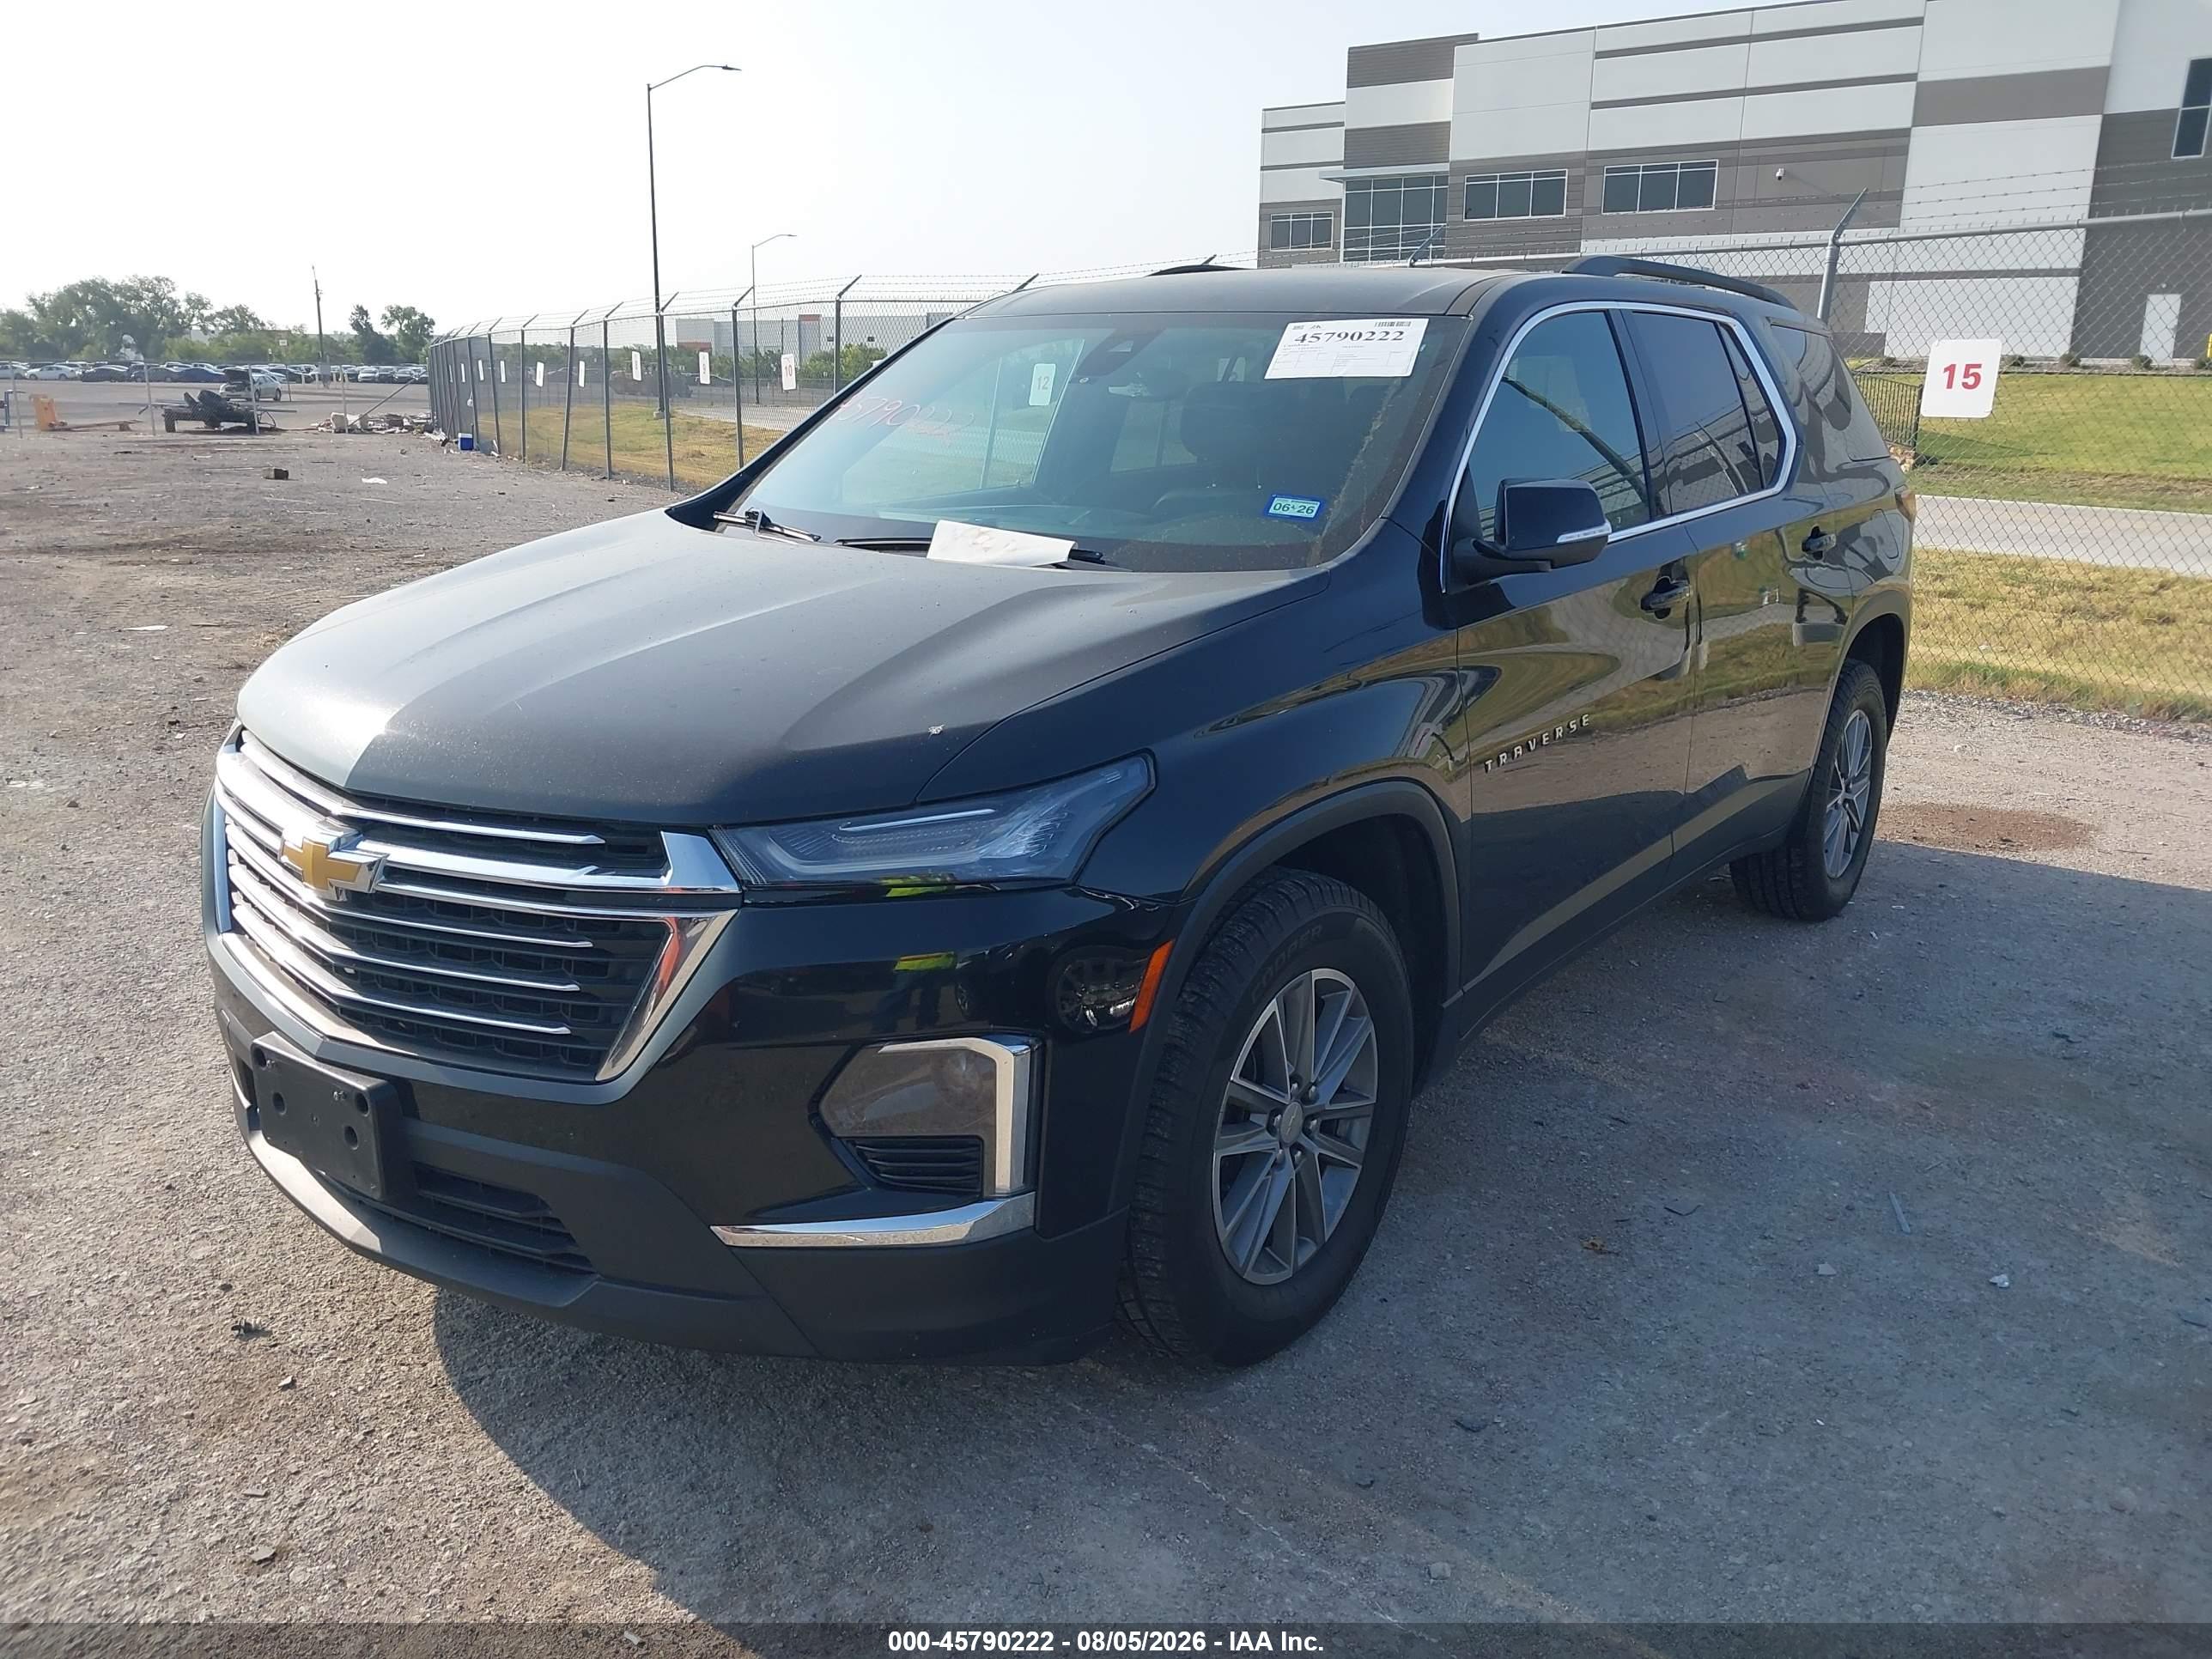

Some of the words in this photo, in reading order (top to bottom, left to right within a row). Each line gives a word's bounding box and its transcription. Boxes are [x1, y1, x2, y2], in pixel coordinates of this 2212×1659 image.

[1294, 331, 1405, 343] 45790222
[784, 364, 793, 378] 10
[1942, 363, 1983, 390] 15
[1037, 376, 1050, 390] 12
[1484, 714, 1589, 773] TRAVERSE
